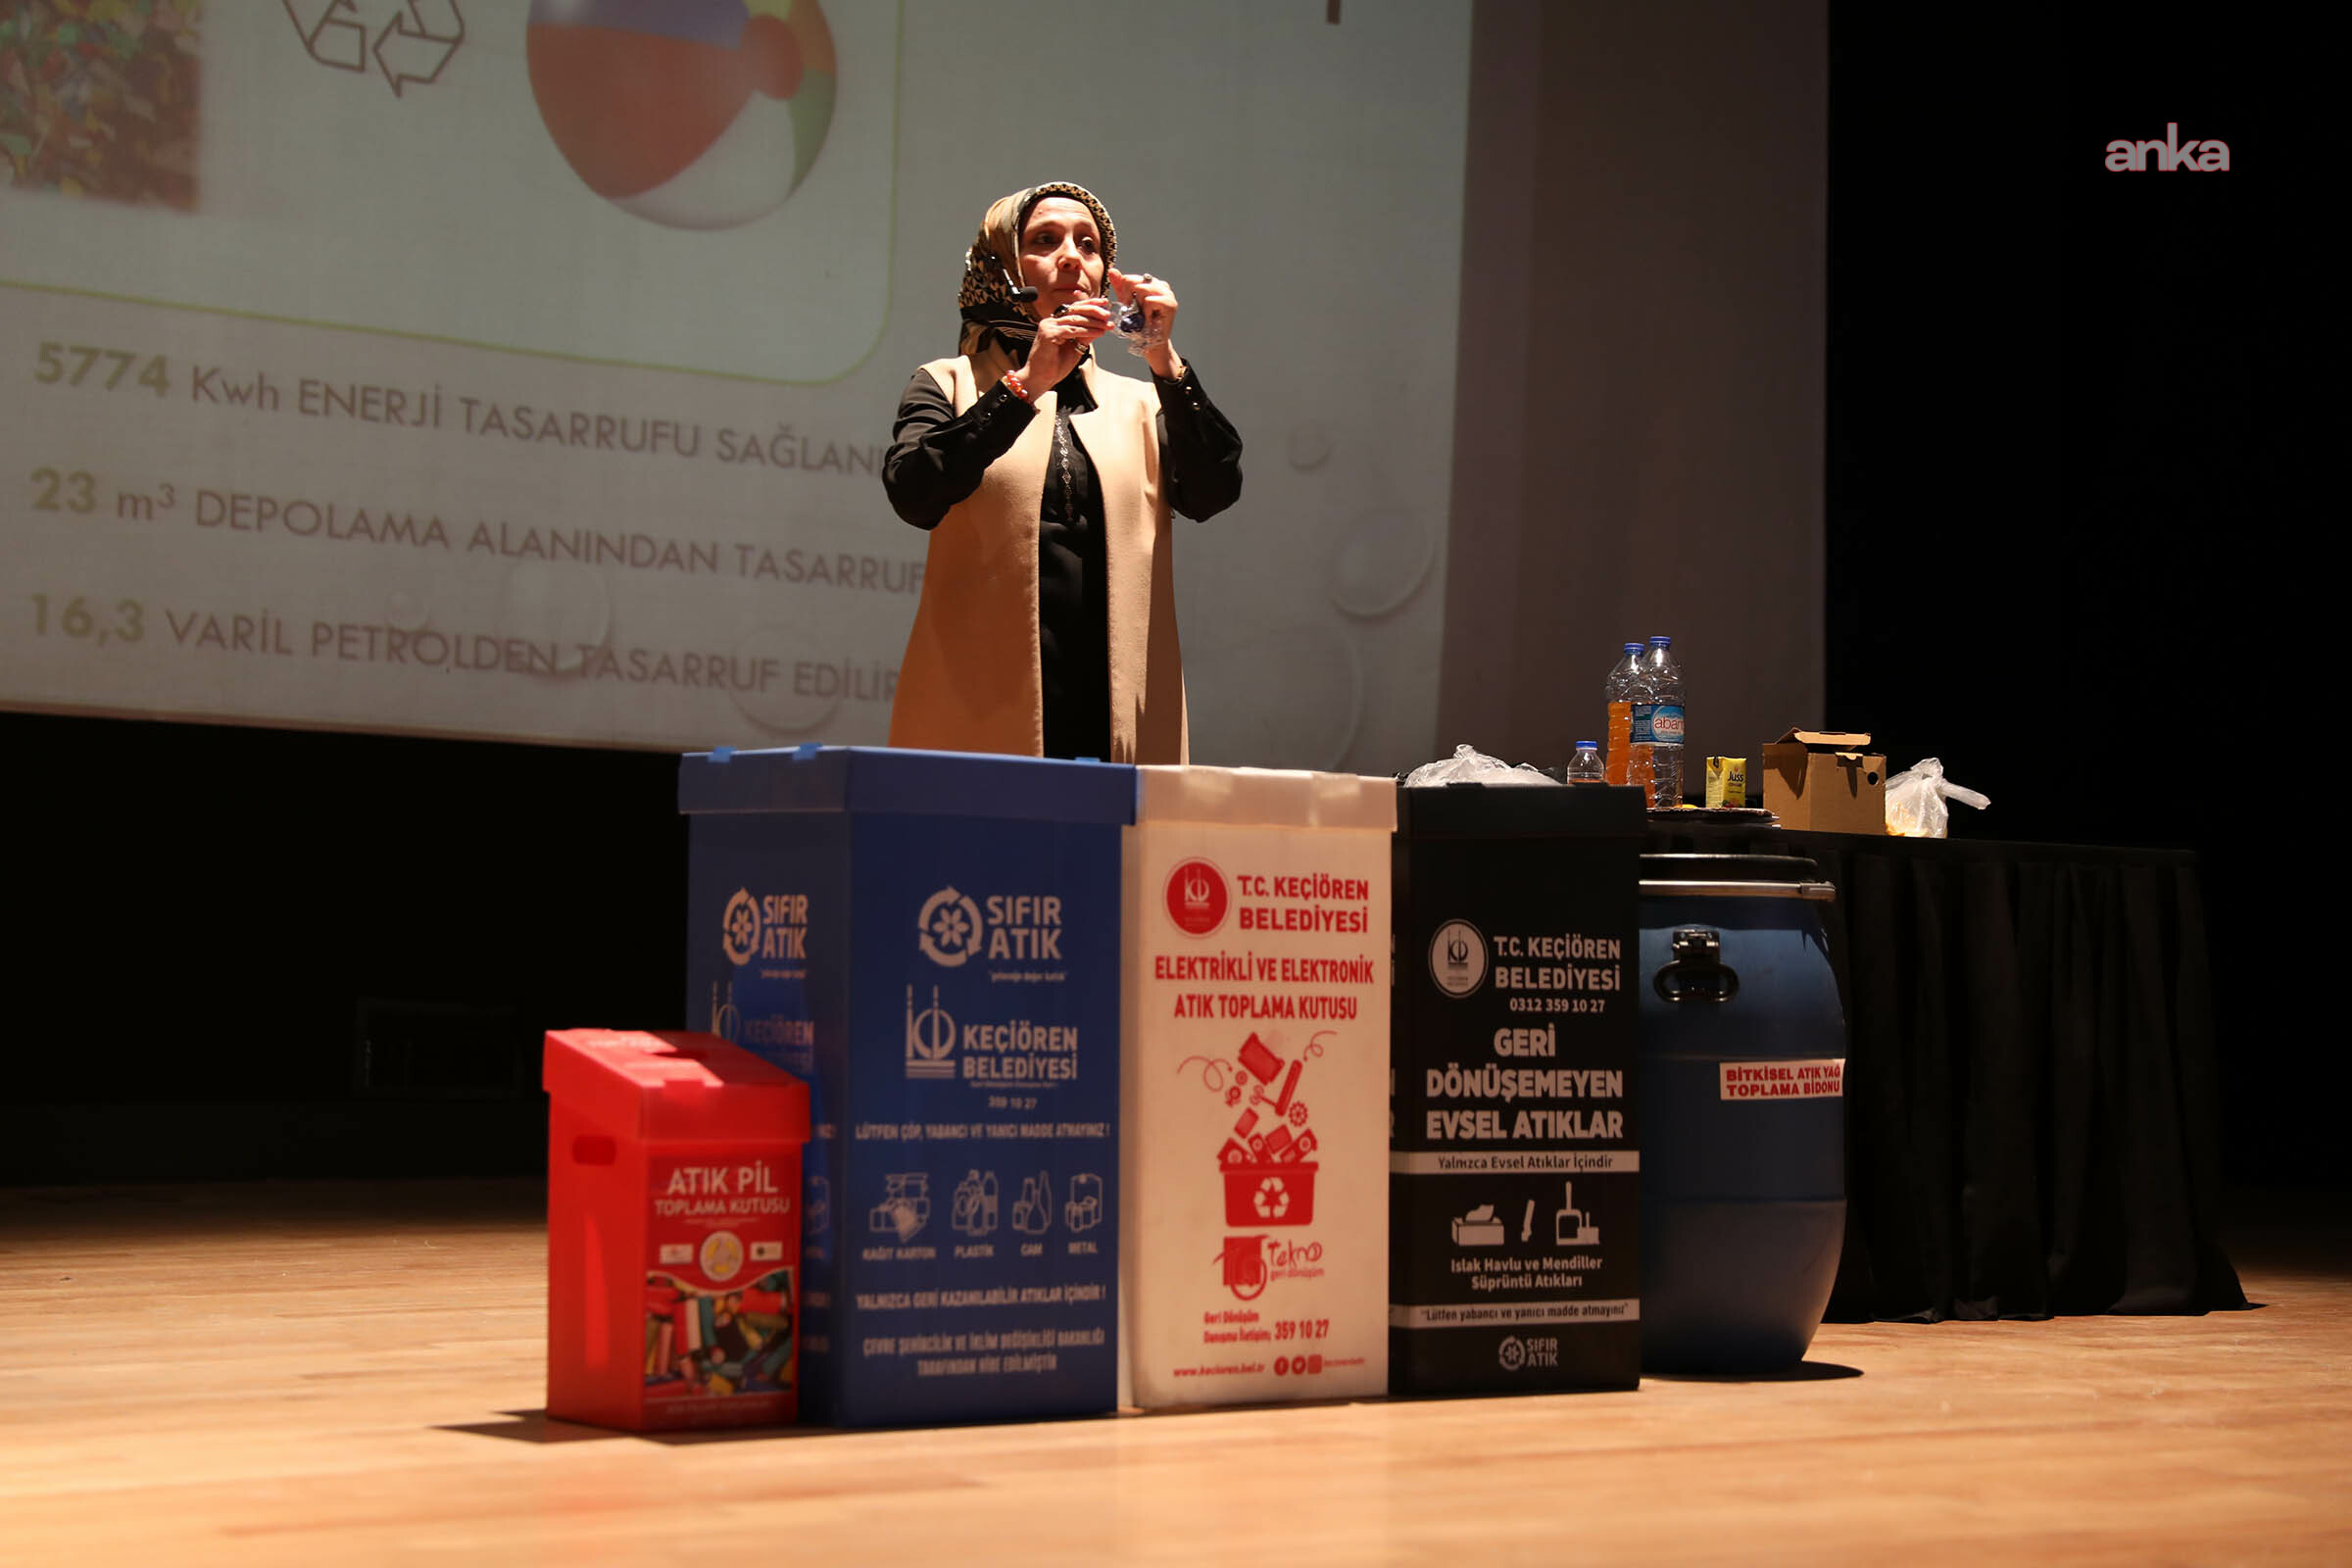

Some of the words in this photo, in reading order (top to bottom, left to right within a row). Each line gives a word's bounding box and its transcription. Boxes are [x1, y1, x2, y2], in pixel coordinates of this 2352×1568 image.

[34, 342, 170, 397] 5774
[192, 366, 279, 411] Kwh
[298, 378, 441, 428] ENERJİ
[460, 397, 700, 458] TASARRUFU
[717, 421, 885, 477] SAĞLANI
[30, 467, 96, 514] 23
[196, 489, 449, 549] DEPOLAMA
[467, 521, 717, 573] ALANINDAN
[735, 543, 924, 595] TASARRUF
[31, 594, 144, 647] 16,3
[165, 608, 292, 656] VARİL
[312, 621, 557, 675] PETROLDEN
[576, 644, 778, 693] TASARRUF
[1728, 771, 1744, 782] Juss
[1237, 875, 1269, 897] T.C.
[1274, 872, 1369, 901] KEÇİÖREN
[763, 895, 808, 924] SIFIR
[986, 896, 1061, 925] SIFIR
[1240, 905, 1368, 933] BELEDİYESİ
[761, 927, 808, 959] ATIK
[988, 928, 1062, 959] ATIK
[1494, 936, 1524, 956] T.C.
[1528, 933, 1621, 959] KEÇİÖREN
[1155, 950, 1252, 981] ELEKTRİKLİ
[1256, 957, 1277, 981] VE
[1281, 954, 1374, 984] ELEKTRONİK
[1494, 964, 1620, 991] BELEDİYESİ
[1174, 994, 1214, 1018] ATIK
[1218, 994, 1295, 1019] TOPLAMA
[1298, 996, 1357, 1020] KUTUSU
[1509, 998, 1543, 1012] 0312
[1545, 999, 1568, 1012] 359
[1573, 999, 1587, 1012] 10
[1591, 999, 1605, 1012] 27
[962, 1019, 1078, 1054] KEÇİÖREN
[1494, 1022, 1555, 1056] GERİ
[962, 1053, 1077, 1080] BELEDİYESİ
[1726, 1065, 1793, 1082] BİTKİSEL
[1797, 1065, 1821, 1080] ATIK
[1824, 1063, 1840, 1078] YAĞ
[1426, 1062, 1623, 1102] DÖNÜŞEMEYEN
[1727, 1083, 1799, 1097] TOPLAMA
[1803, 1079, 1839, 1095] BİDONU
[1426, 1110, 1507, 1139] EVSEL
[1512, 1110, 1623, 1139] ATIKLAR
[1438, 1155, 1488, 1169] Yalnızca
[1492, 1153, 1524, 1168] Evsel
[1527, 1152, 1570, 1168] Atıklar
[1574, 1152, 1613, 1171] İçindir
[667, 1166, 729, 1195] ATIK
[737, 1160, 779, 1194] PİL
[655, 1199, 726, 1216] TOPLAMA
[729, 1197, 790, 1215] KUTUSU
[1068, 1242, 1098, 1254] METAL
[1450, 1257, 1480, 1273] Islak
[1484, 1256, 1521, 1272] Havlu
[1525, 1260, 1539, 1270] ve
[1543, 1255, 1602, 1271] Mendiller
[1471, 1275, 1532, 1292] Süprüntü
[1535, 1273, 1583, 1287] Atıkları
[1500, 1309, 1512, 1318] ve
[1547, 1304, 1580, 1317] madde
[1275, 1321, 1296, 1341] 359
[1299, 1320, 1312, 1340] 10
[1315, 1319, 1330, 1339] 27
[1526, 1338, 1558, 1352] SIFIR
[1527, 1352, 1558, 1367] ATIK
